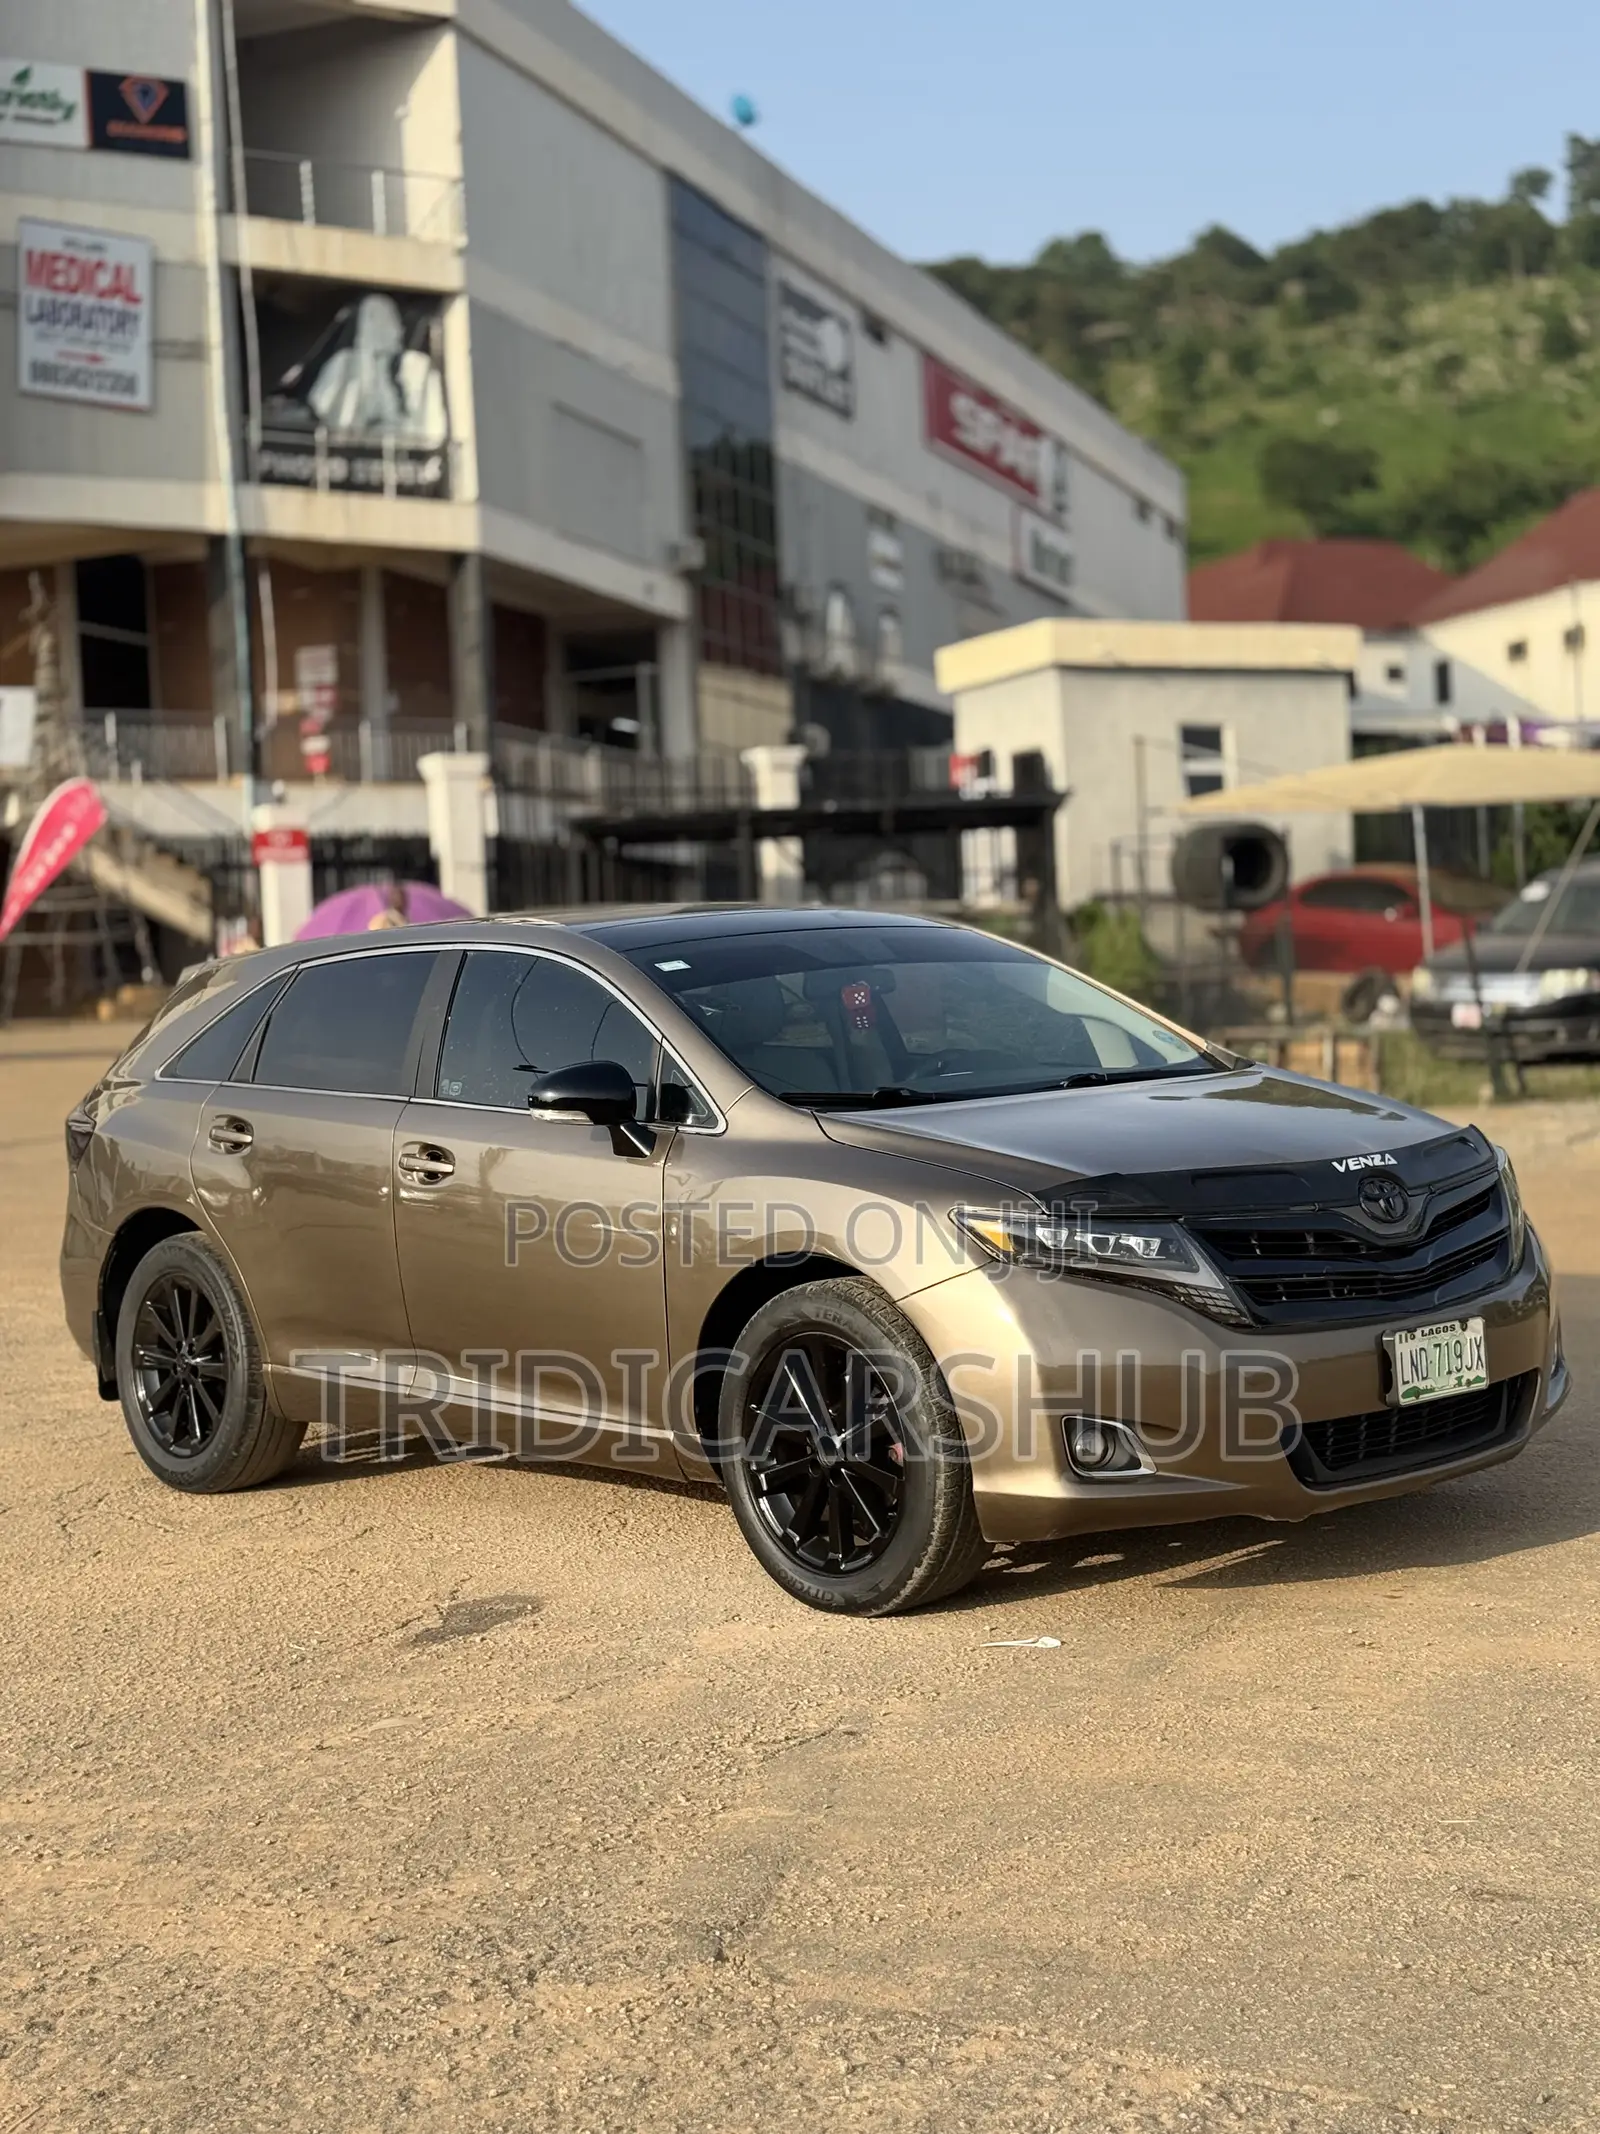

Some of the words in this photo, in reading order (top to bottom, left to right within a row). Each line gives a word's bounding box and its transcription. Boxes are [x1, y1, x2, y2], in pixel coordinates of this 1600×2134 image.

[26, 249, 142, 305] MEDICAL
[1331, 1153, 1398, 1173] VENZA
[1420, 1323, 1457, 1338] LAGOS
